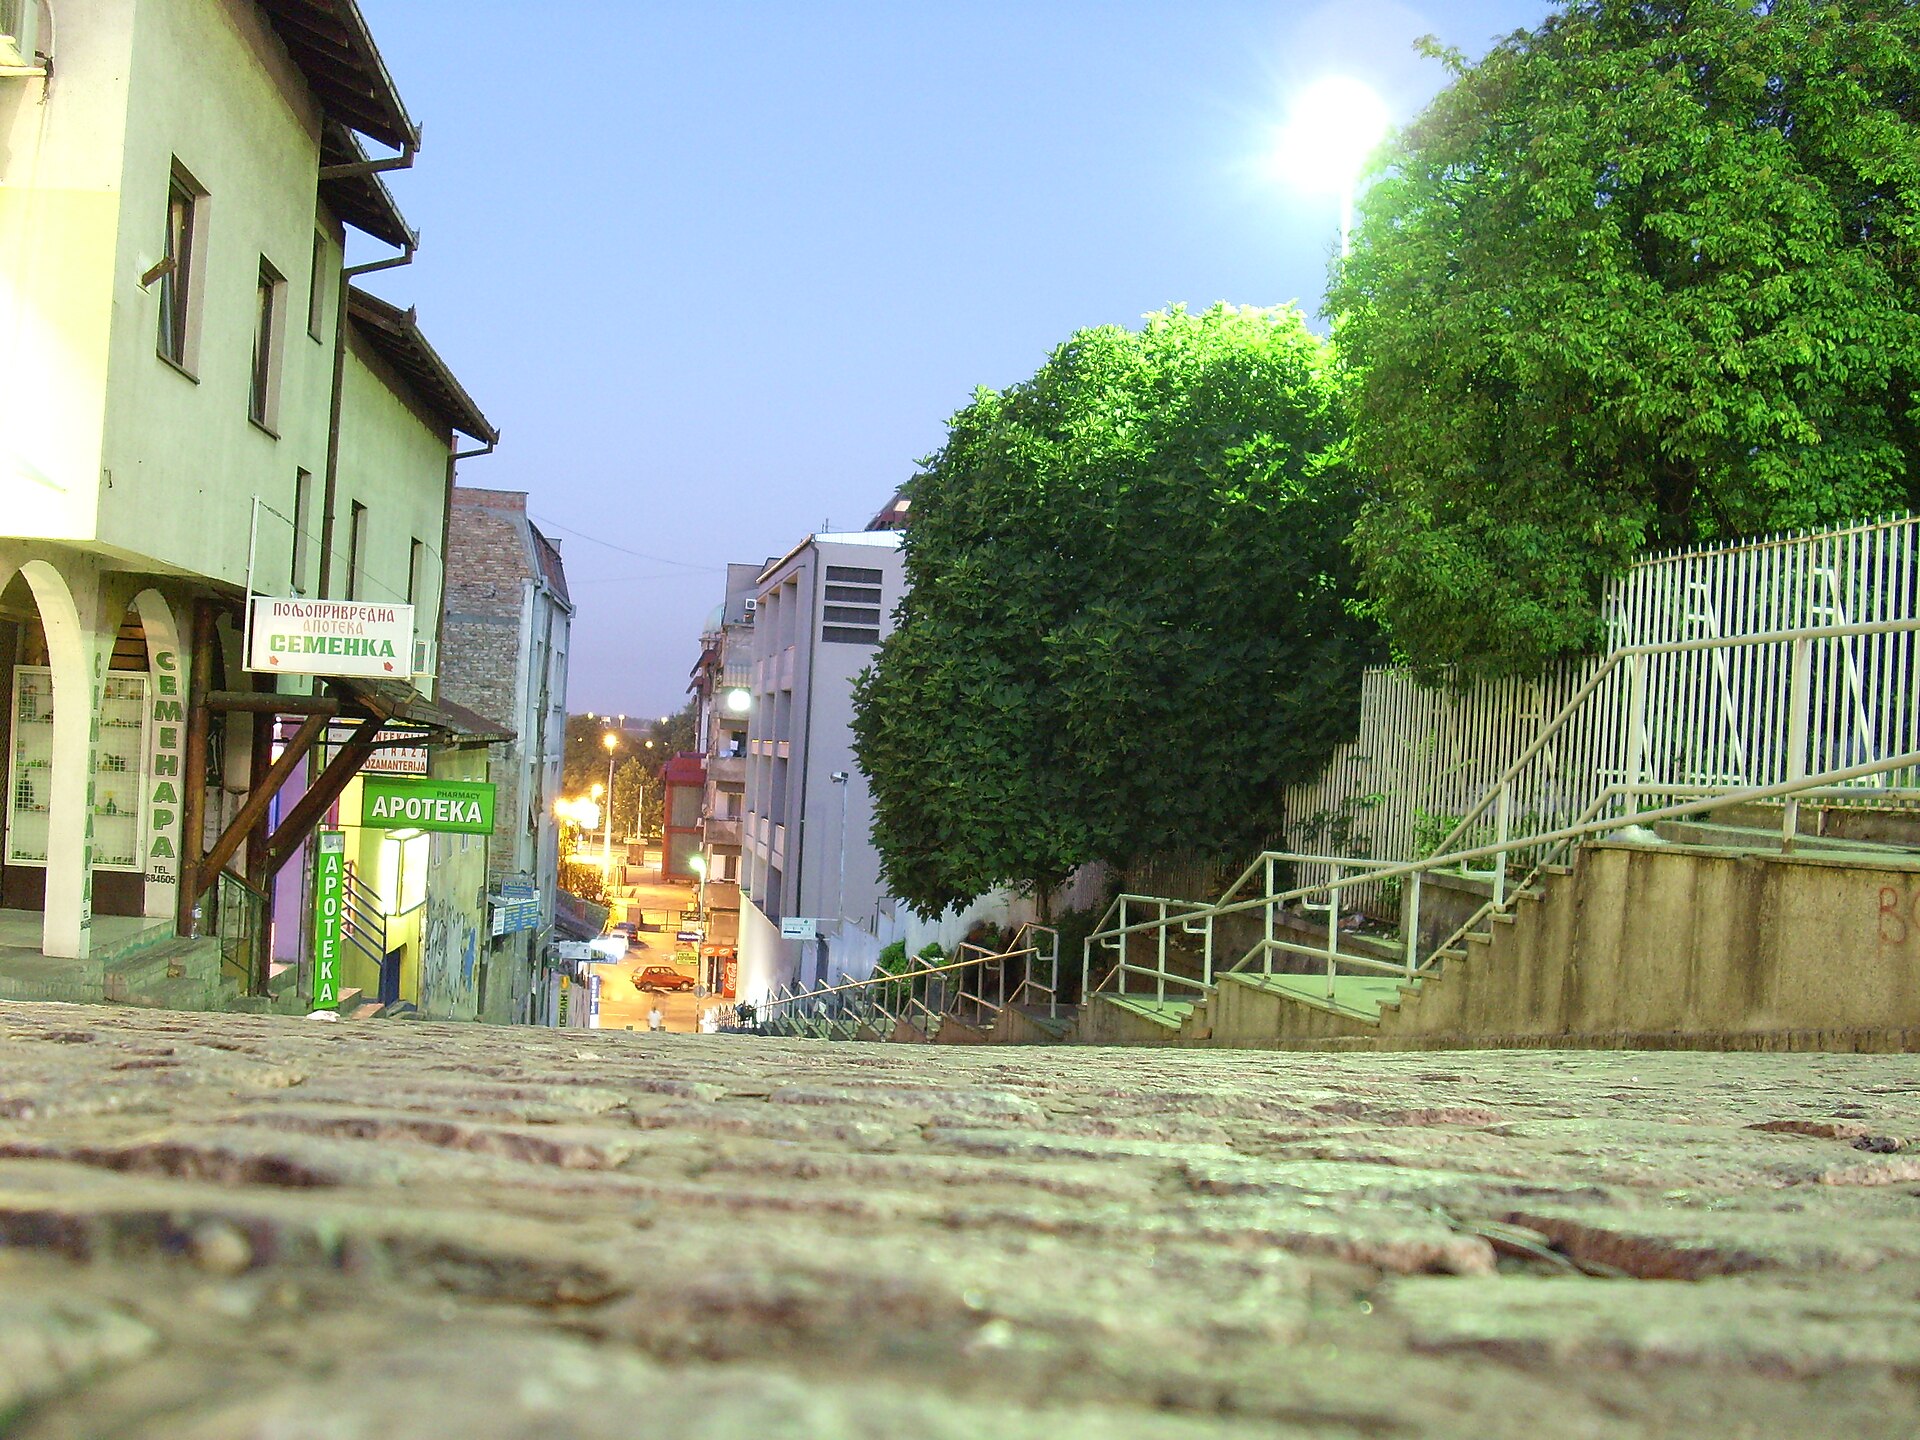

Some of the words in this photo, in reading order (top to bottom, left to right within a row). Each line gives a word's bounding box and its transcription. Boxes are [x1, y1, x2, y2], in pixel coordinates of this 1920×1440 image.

[303, 619, 364, 635] АПОТЕКА
[270, 634, 396, 658] СЕМЕНКА
[150, 651, 183, 858] СЕМЕНАРА
[363, 758, 426, 772] OZAMANTERIJA
[436, 790, 481, 800] PHARMACY
[371, 795, 483, 824] APOTEKA
[319, 855, 339, 1002] APOTEKA
